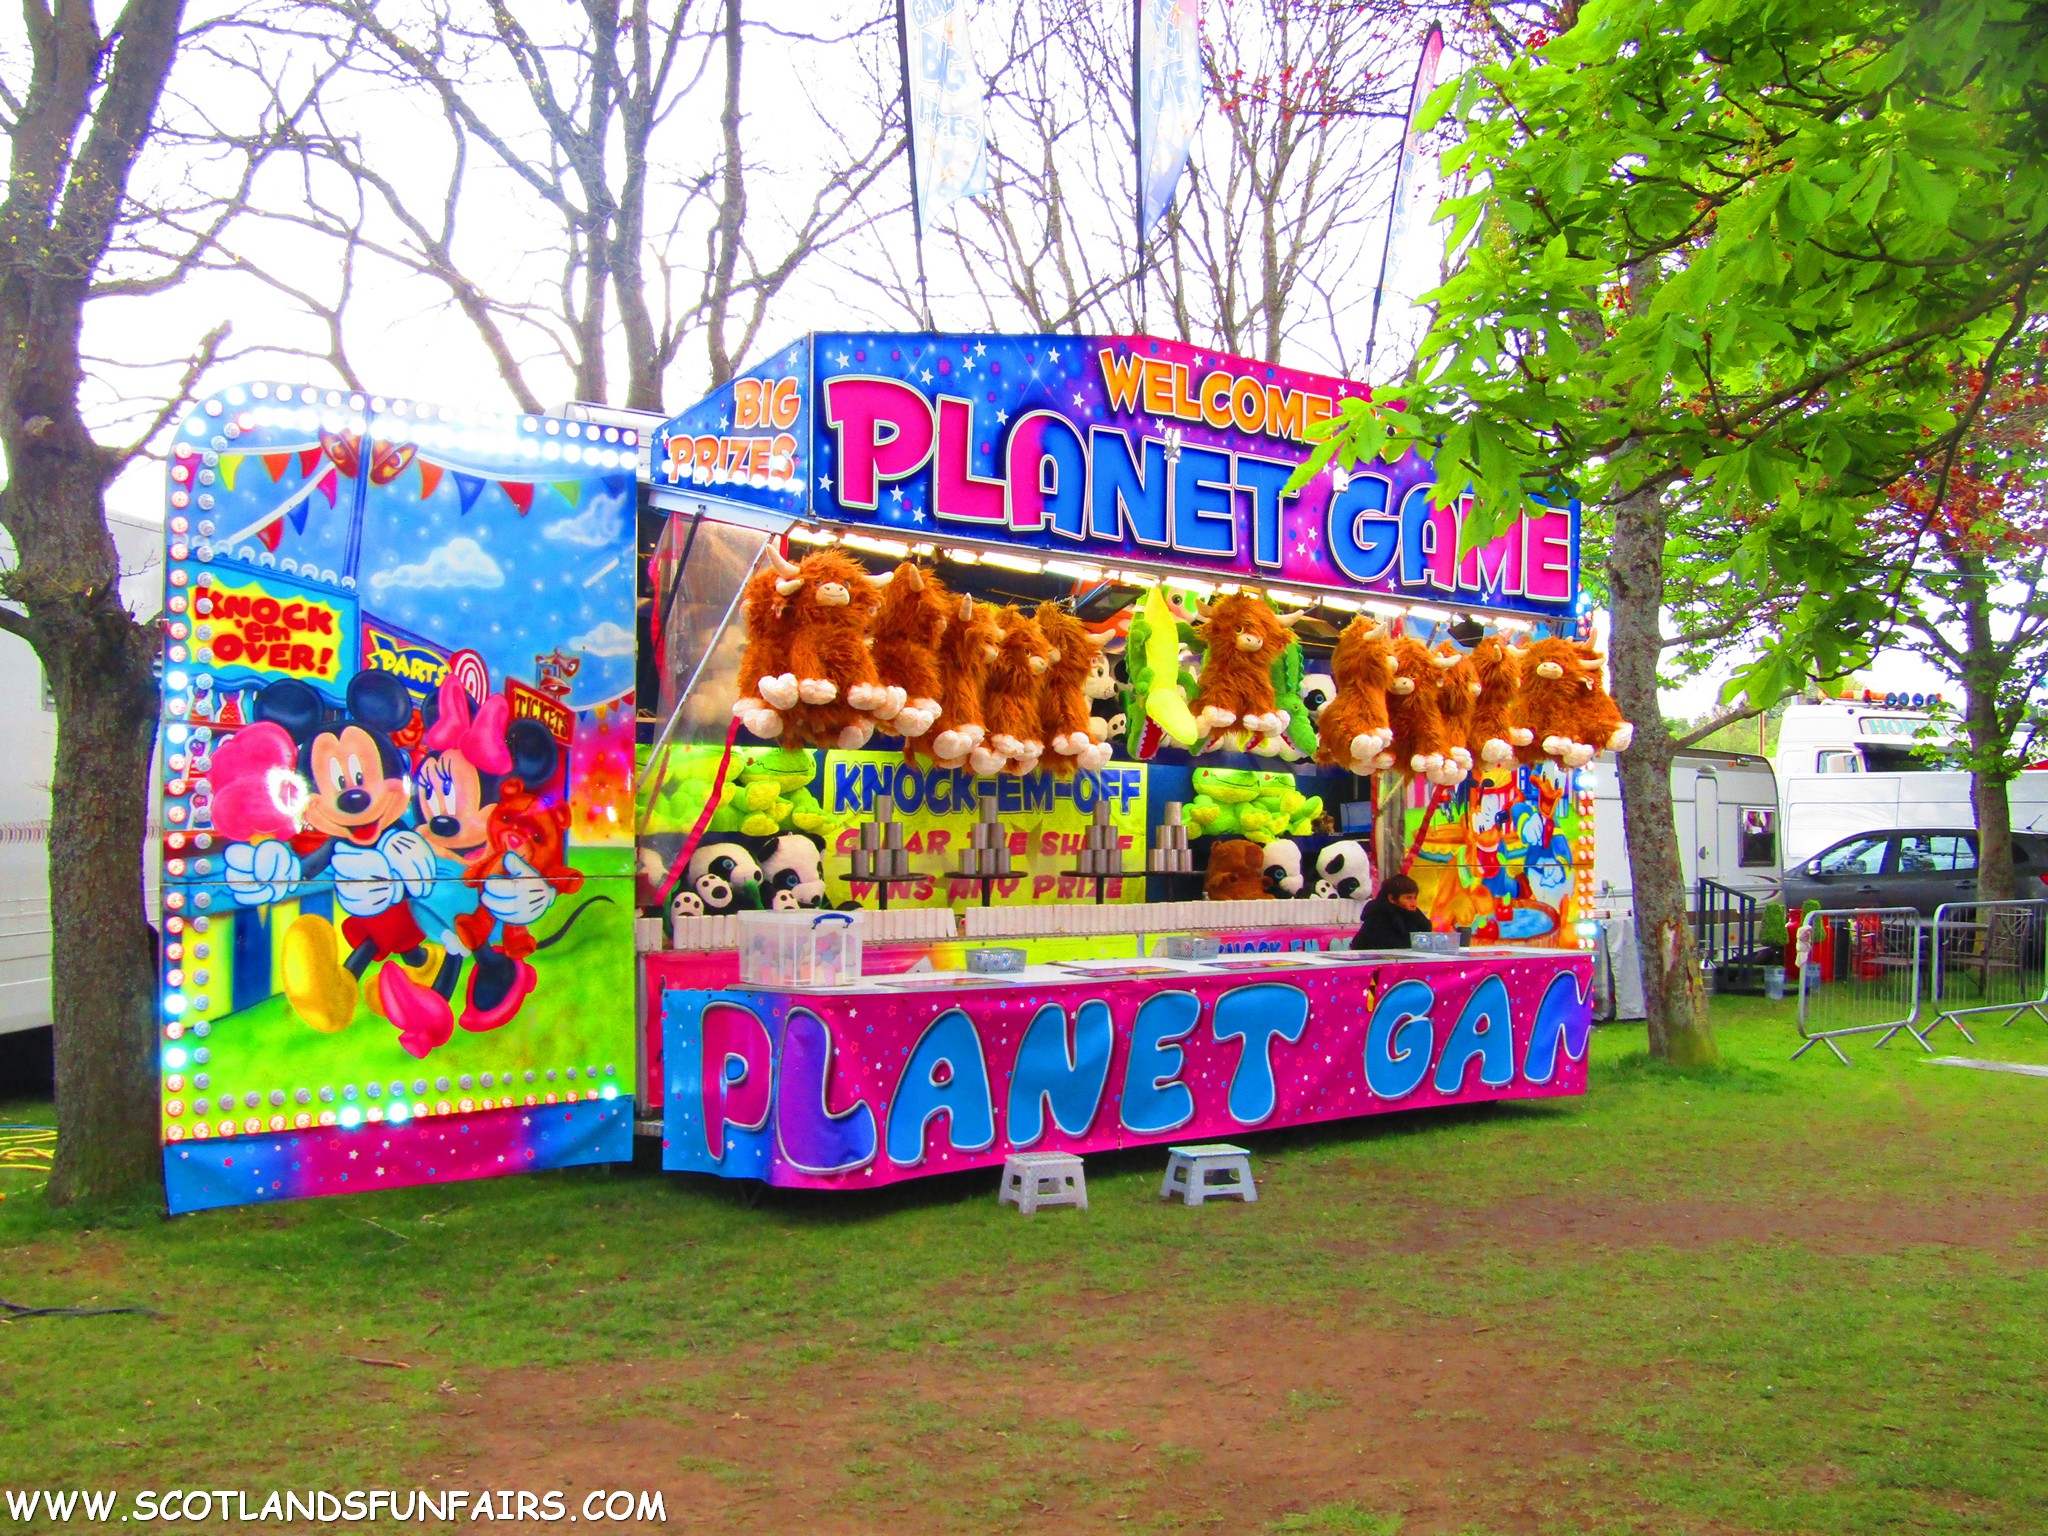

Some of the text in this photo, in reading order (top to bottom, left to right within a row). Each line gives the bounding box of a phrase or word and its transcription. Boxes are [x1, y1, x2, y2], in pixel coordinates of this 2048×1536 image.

[734, 376, 801, 430] BIG
[1099, 348, 1333, 446] WELCOME
[667, 433, 798, 488] PRIZES
[823, 374, 1571, 602] PLANET GAME
[195, 587, 333, 636] KNOCK
[212, 634, 334, 675] OVER!
[380, 649, 450, 687] DARTS
[514, 692, 570, 738] TICKETS
[833, 760, 1142, 816] KNOCK-EM-OFF
[835, 828, 951, 856] CAR
[1040, 831, 1134, 857] SHF
[701, 982, 1310, 1174] PLANET
